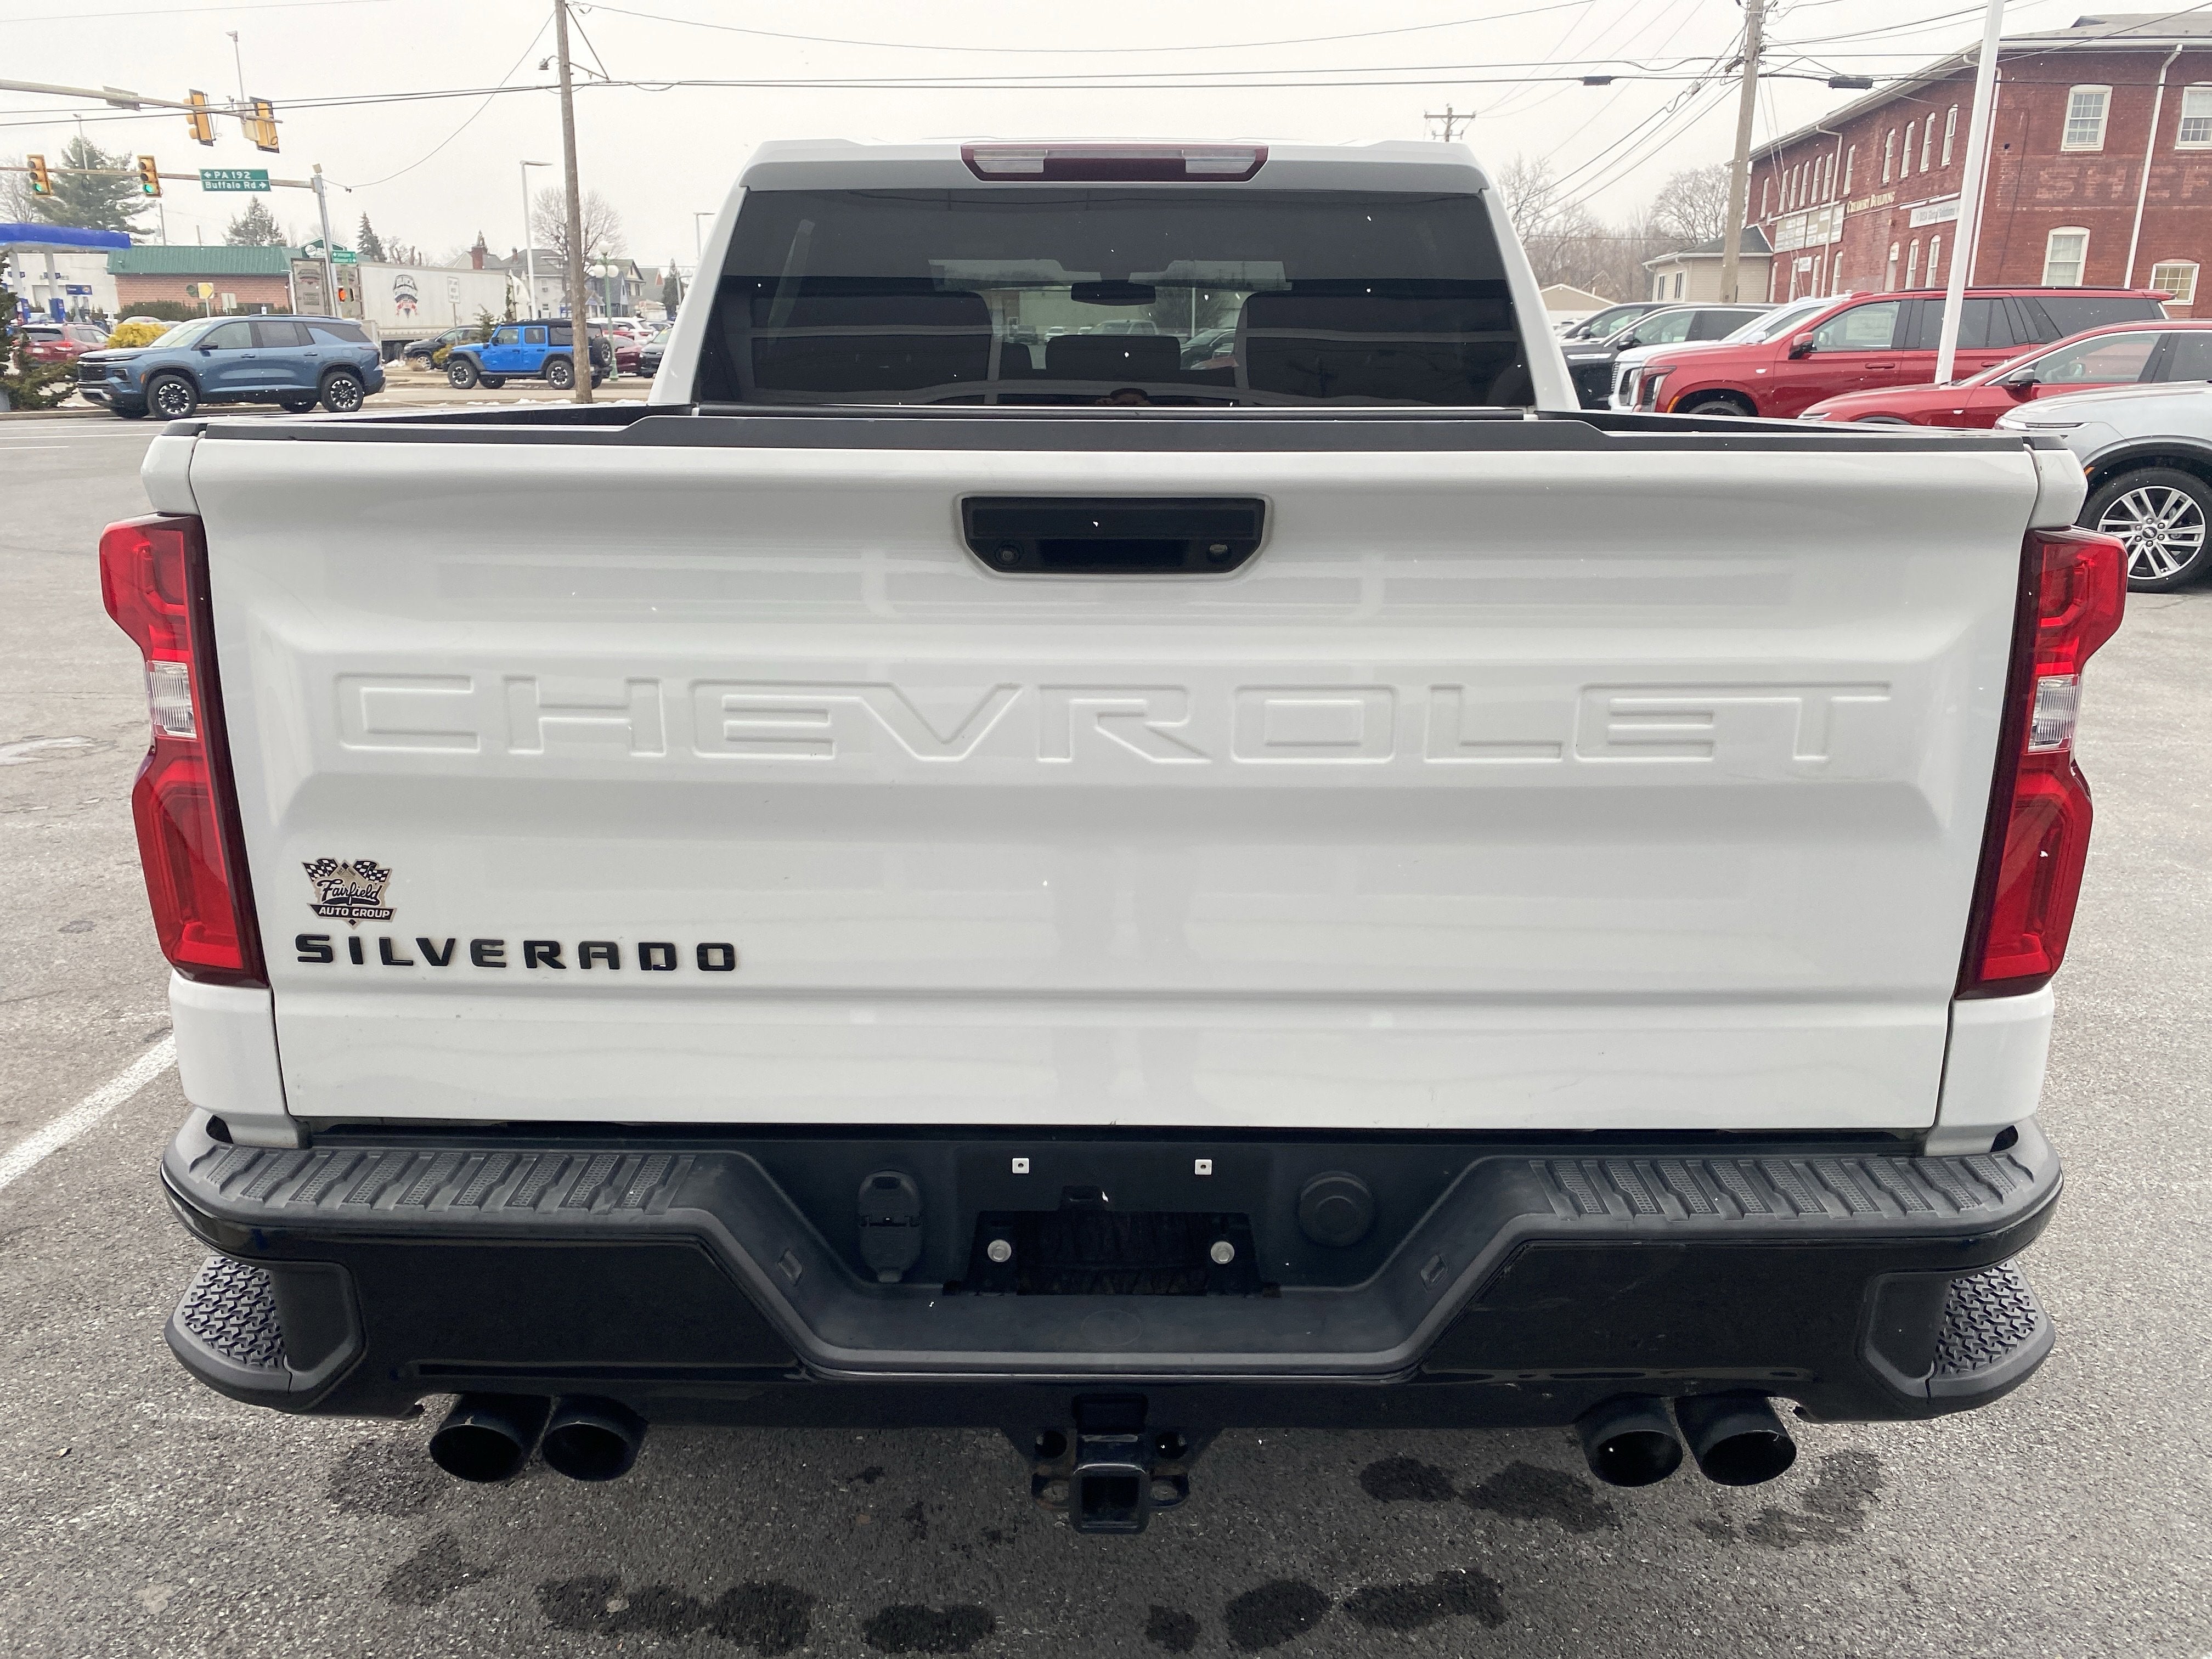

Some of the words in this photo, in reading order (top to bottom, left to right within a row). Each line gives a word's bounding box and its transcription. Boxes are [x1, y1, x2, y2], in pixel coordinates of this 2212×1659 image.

[213, 171, 229, 179] PA
[244, 181, 256, 189] Rd
[332, 673, 1892, 769] CHEVROLET
[316, 878, 383, 903] Fairfield
[318, 906, 349, 916] AUTO
[352, 908, 390, 918] GROUP
[295, 933, 736, 972] SILVERADO
